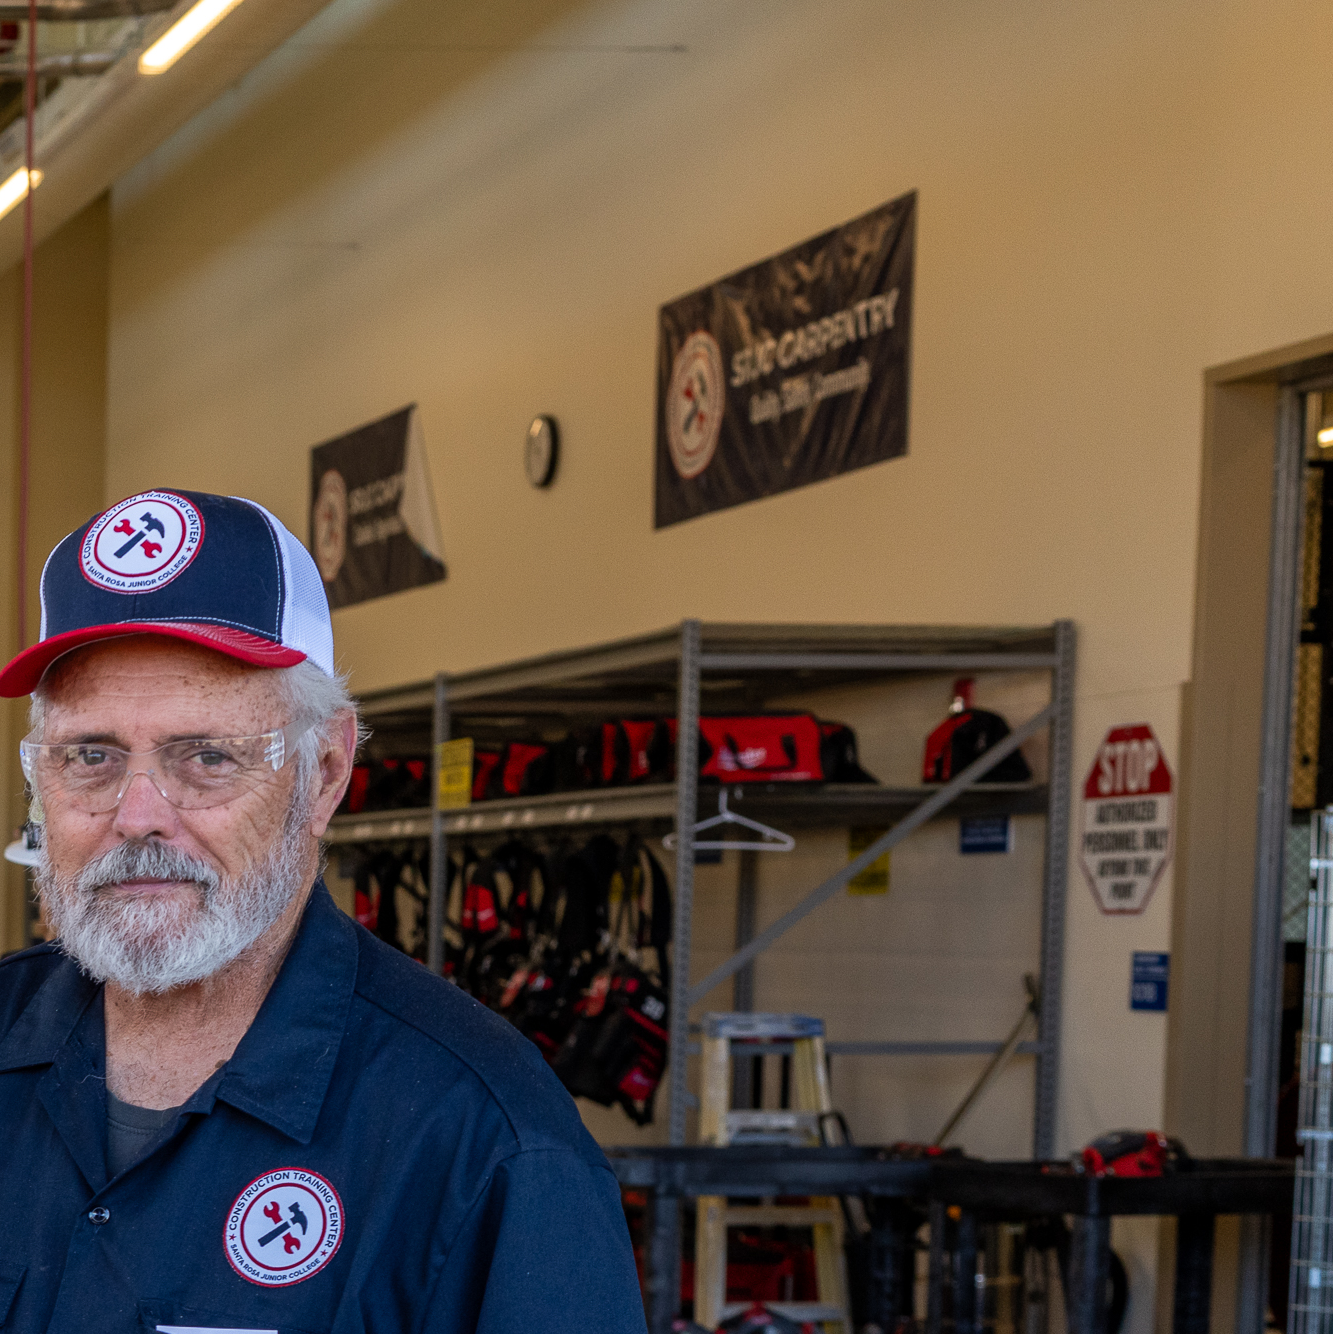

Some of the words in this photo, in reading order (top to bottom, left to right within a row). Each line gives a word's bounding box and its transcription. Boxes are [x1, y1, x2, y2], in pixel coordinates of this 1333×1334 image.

[83, 497, 137, 559] CONSTRUCTION
[141, 492, 188, 509] TRAINING
[185, 508, 199, 544] CENTER
[88, 565, 104, 581] SANTA
[105, 576, 125, 587] ROSA
[127, 578, 157, 588] JUNIOR
[157, 555, 188, 582] COLLEGE
[1097, 739, 1159, 794] STOP
[229, 1171, 290, 1231] CONSTRUCTION
[293, 1172, 333, 1203] TRAINING
[324, 1205, 338, 1248] CENTER
[230, 1244, 245, 1266] SANTA
[243, 1263, 260, 1278] ROSA
[261, 1273, 287, 1281] JUNIOR
[289, 1258, 320, 1279] COLLEGE
